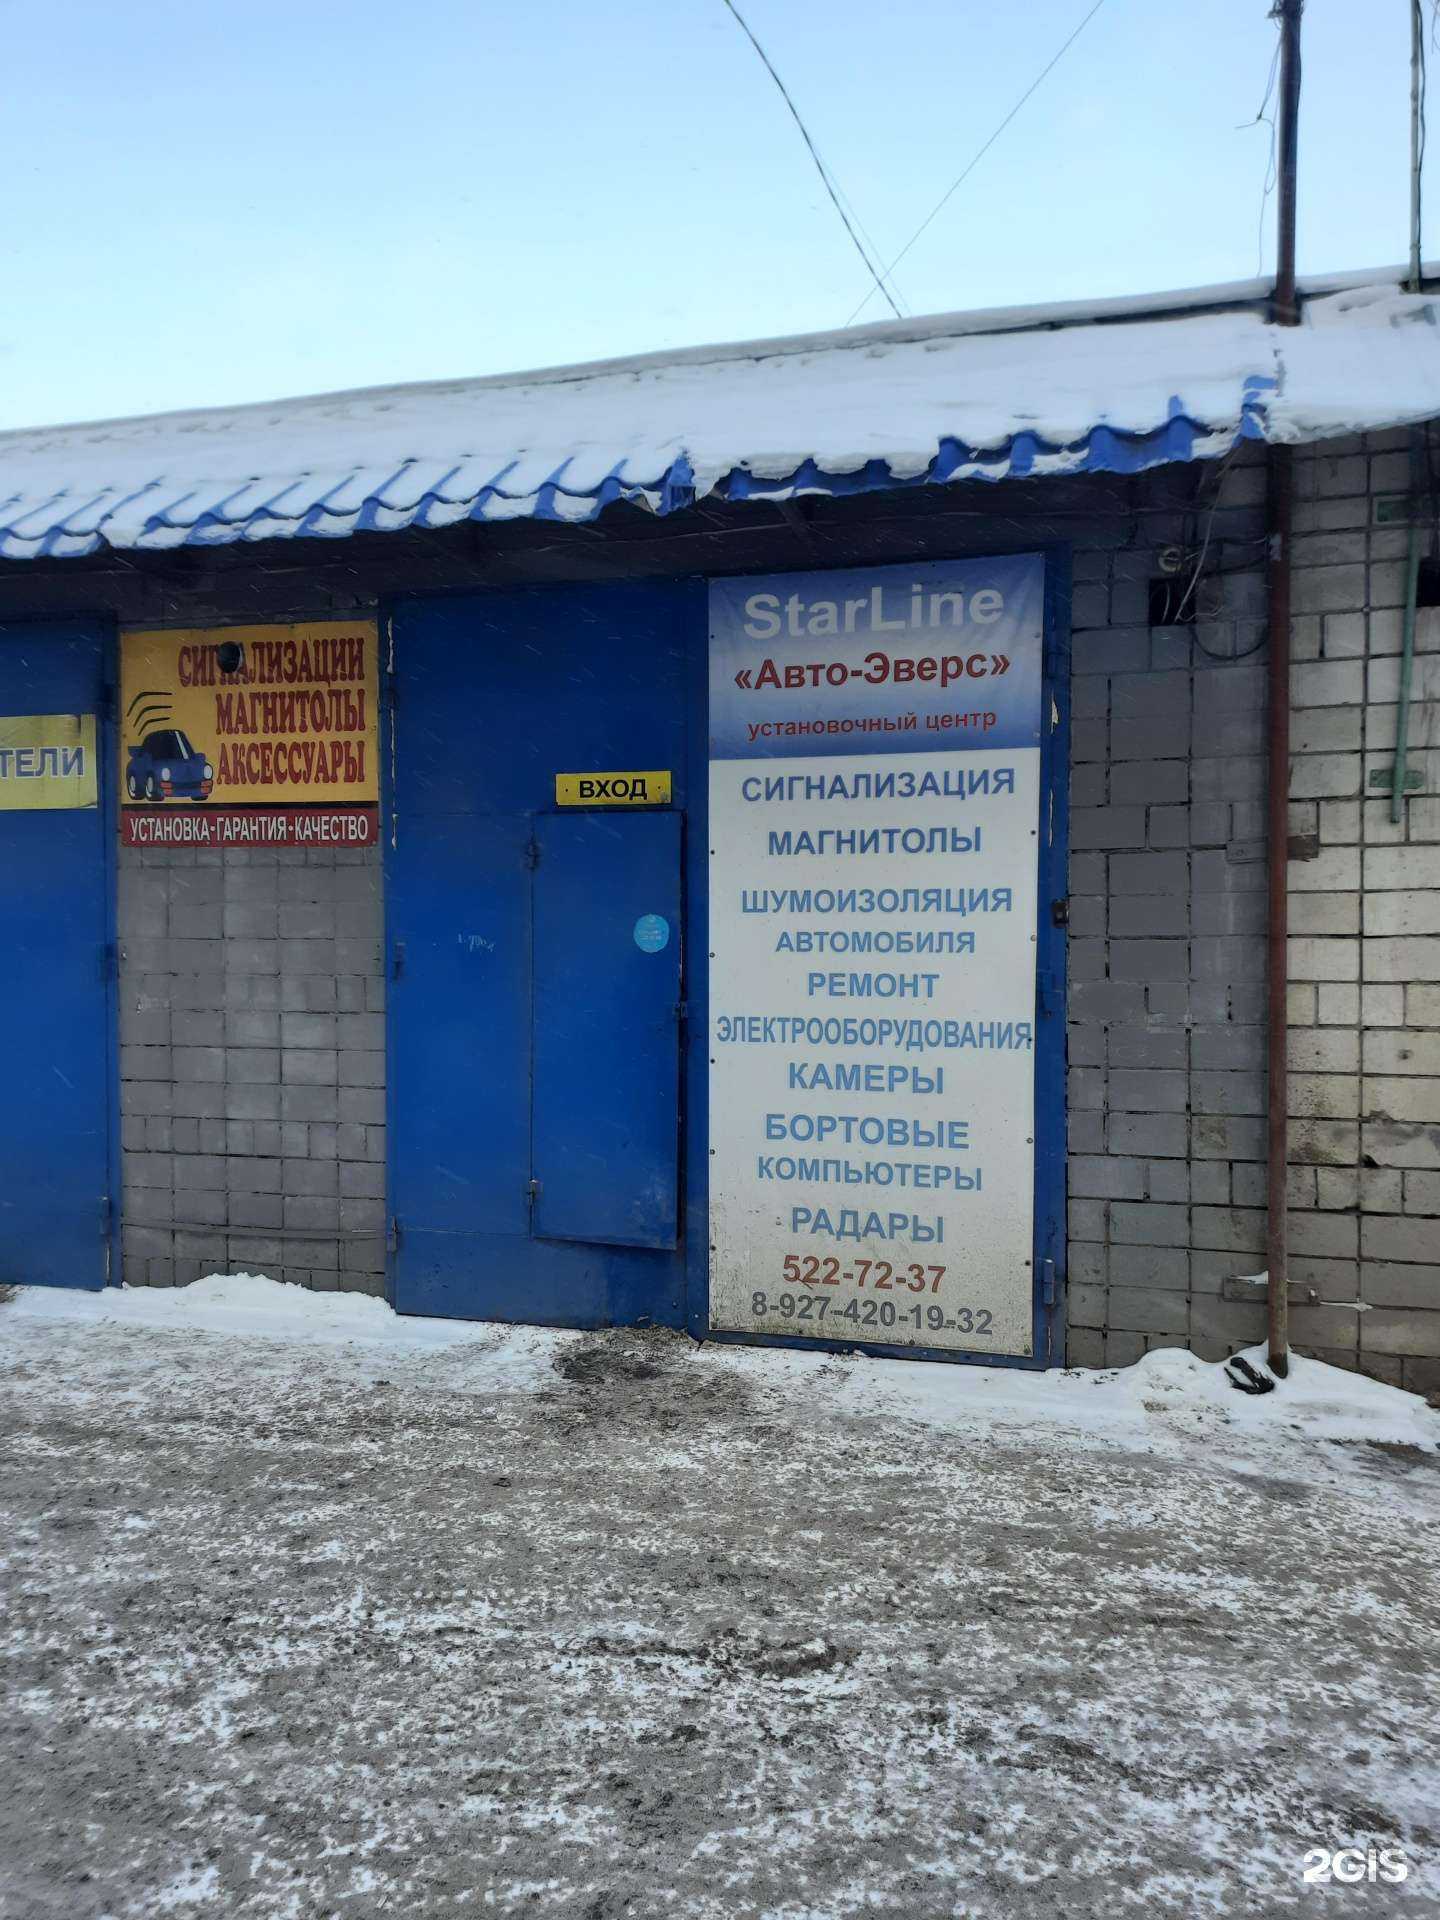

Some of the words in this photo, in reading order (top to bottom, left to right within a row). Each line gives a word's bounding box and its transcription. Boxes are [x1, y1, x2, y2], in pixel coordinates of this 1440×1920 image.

[743, 585, 1004, 640] StarLine
[178, 637, 365, 687] СИГАЛИЗАЦИИ
[734, 651, 1010, 690] «Авто-Эверс»
[215, 689, 366, 734] МАГНИТОЛЫ
[747, 711, 917, 742] установочный
[926, 708, 997, 735] центр
[216, 741, 366, 784] АКСЕССУАРЫ
[579, 779, 647, 800] ВХОД
[742, 768, 1015, 802] СИГНАЛИЗАЦИЯ
[768, 827, 981, 856] МАГНИТОЛЫ
[742, 888, 1013, 917] ШУМОИЗОЛЯЦИЯ
[775, 931, 976, 953] АВТОМОБИЛЯ
[807, 972, 940, 998] РЕМОНТ
[717, 1016, 1032, 1051] ЭЛЕКТРООБОРУДОВАНИЯ
[789, 1063, 944, 1094] КАМЕРЫ
[766, 1114, 970, 1149] БОРТОВЫЕ
[757, 1157, 982, 1191] КОМПЬЮТЕРЫ
[792, 1207, 944, 1243] РАДАРЫ
[783, 1255, 946, 1293] 522-72-37
[752, 1291, 993, 1335] 8-927-420-19-32
